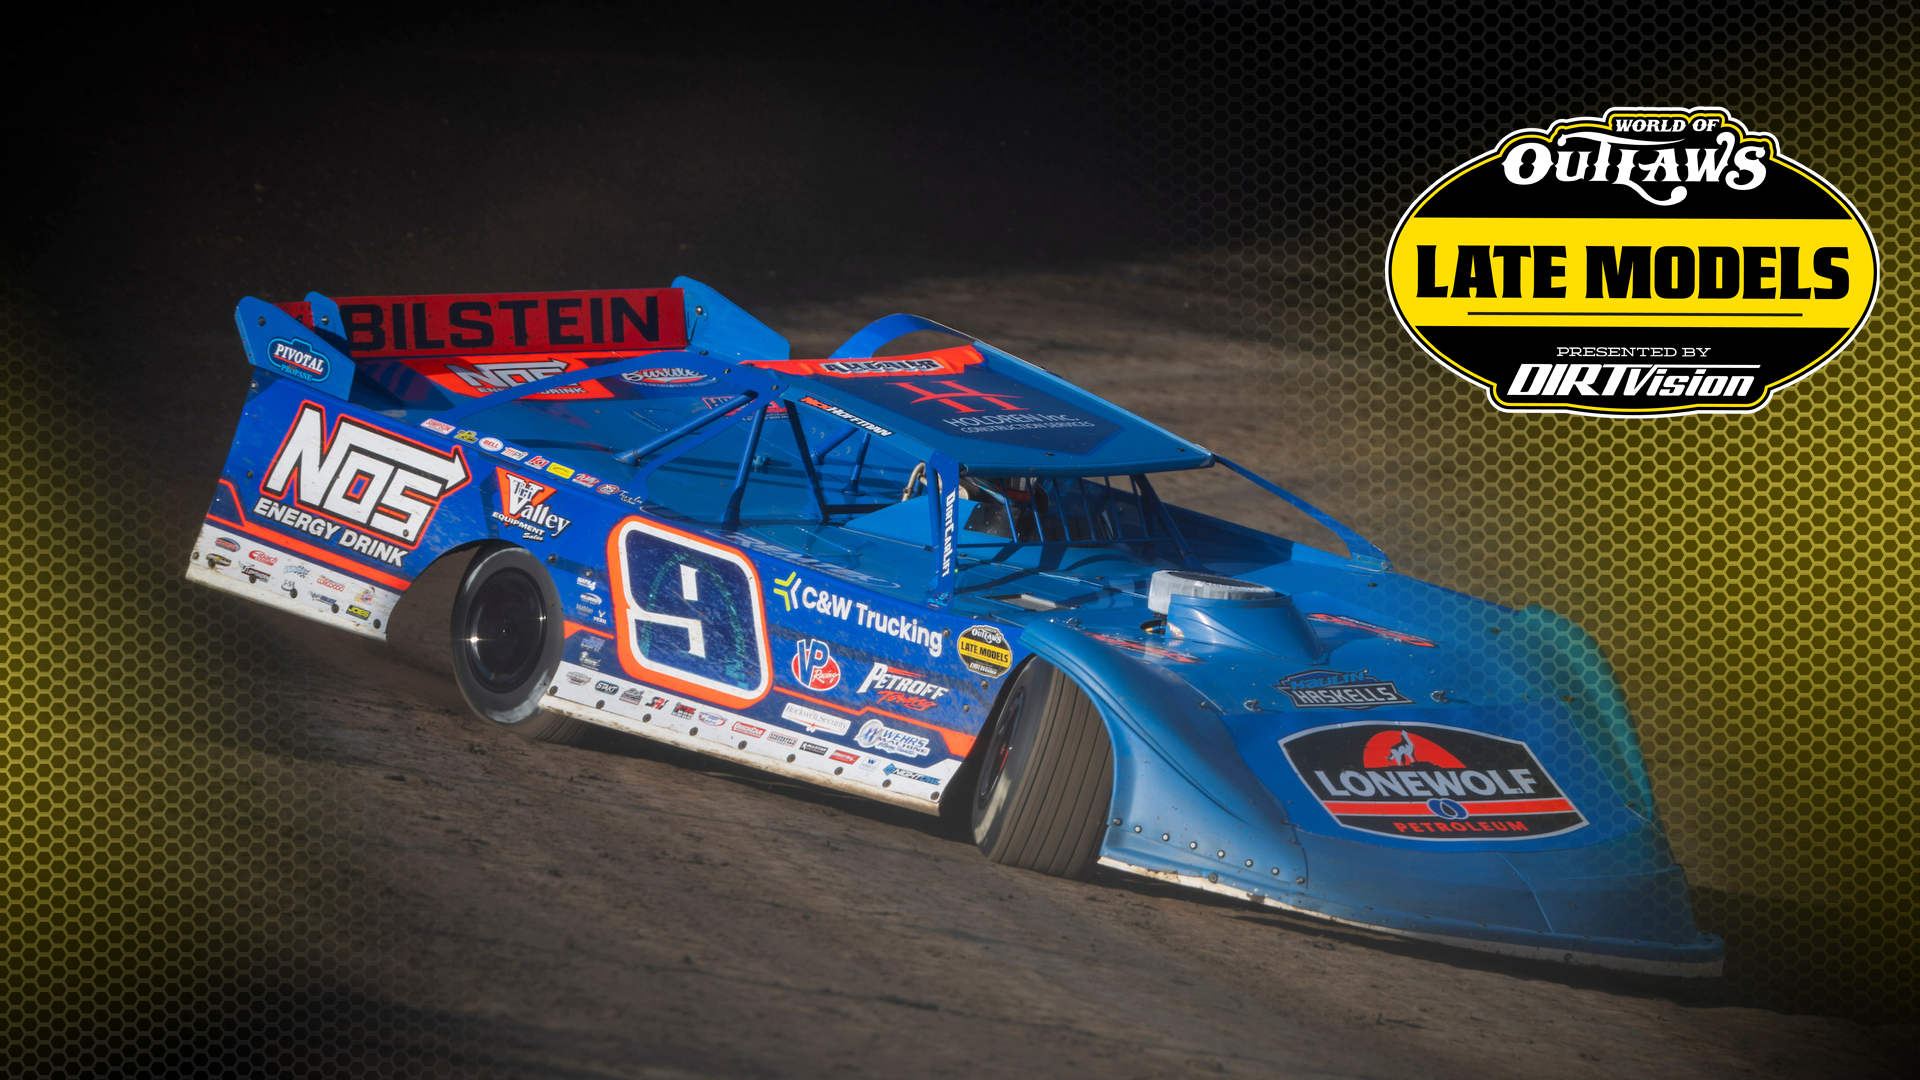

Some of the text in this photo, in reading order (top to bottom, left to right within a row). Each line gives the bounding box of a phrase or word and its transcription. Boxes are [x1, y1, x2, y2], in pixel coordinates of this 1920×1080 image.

[340, 296, 660, 351] BILSTEIN
[274, 343, 326, 373] PIVOTAL
[280, 363, 313, 383] PROPANE
[425, 419, 453, 432] SIMPSON
[801, 396, 834, 411] NICK
[827, 405, 893, 437] HOFFMAN
[943, 413, 1080, 427] HOLDREN Inc.
[961, 421, 1096, 434] CONSTRUCTION SERVICES
[482, 439, 499, 449] BELL
[266, 407, 466, 543] NOS
[513, 479, 535, 499] Tri
[507, 474, 571, 537] Valley
[253, 497, 410, 568] ENERGY DRINK
[492, 511, 546, 536] EQUIPMENT
[522, 532, 545, 542] Sales
[248, 549, 279, 565] Eibach
[347, 605, 370, 618] JOES
[612, 517, 771, 705] 9
[802, 586, 943, 658] C&W Trucking
[960, 641, 1009, 664] LATE MODELS
[796, 638, 831, 691] VP
[812, 669, 839, 684] Racing
[856, 662, 949, 700] PETROFF
[876, 690, 938, 711] Towing
[1291, 685, 1400, 706] HASKELLS
[785, 705, 849, 730] Rockwell Security
[877, 736, 932, 755] MACHINE
[883, 729, 926, 748] WEHRS
[1313, 768, 1538, 798] LONEWOLF
[1392, 821, 1530, 833] PETROLEUM
